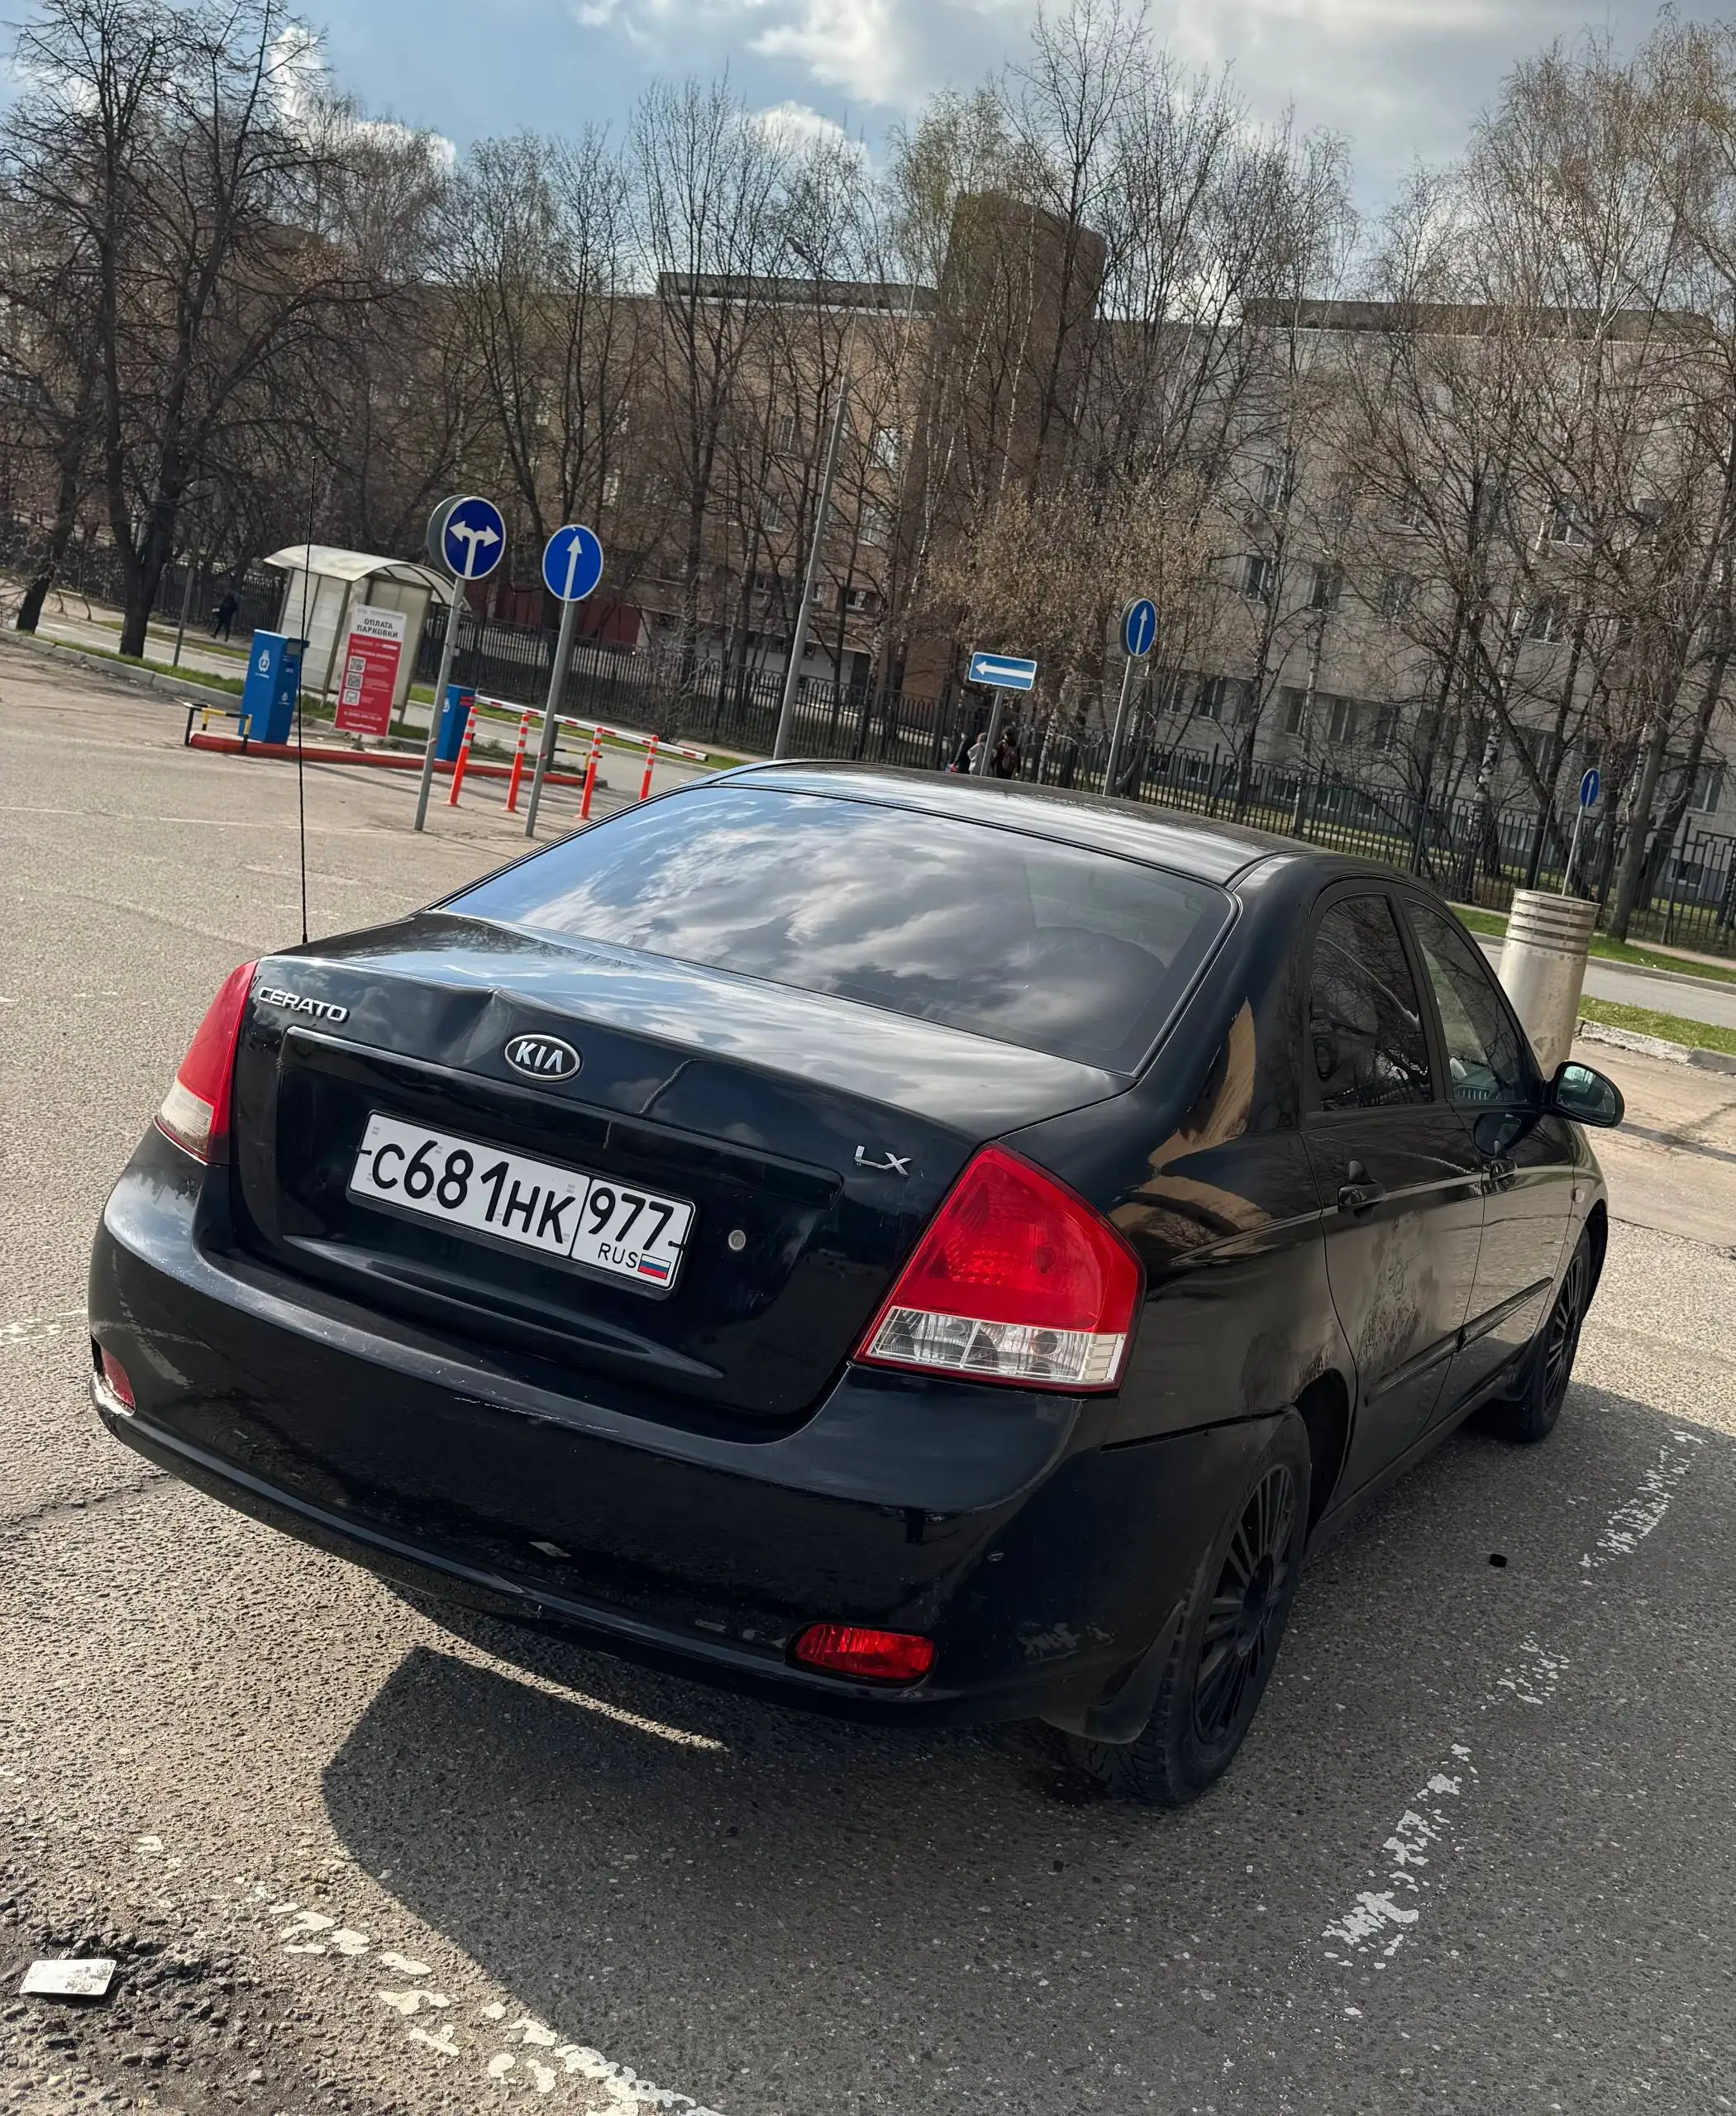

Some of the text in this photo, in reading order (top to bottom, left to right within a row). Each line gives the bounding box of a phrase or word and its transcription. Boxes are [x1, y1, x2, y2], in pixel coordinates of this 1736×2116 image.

[357, 624, 398, 637] ПАРКОВКИ
[365, 618, 393, 629] ОПЛАТА
[259, 986, 348, 1022] CERATO
[515, 1041, 563, 1074] KIA
[854, 1145, 912, 1177] LX
[588, 1187, 674, 1251] 977
[598, 1242, 638, 1269] RUS
